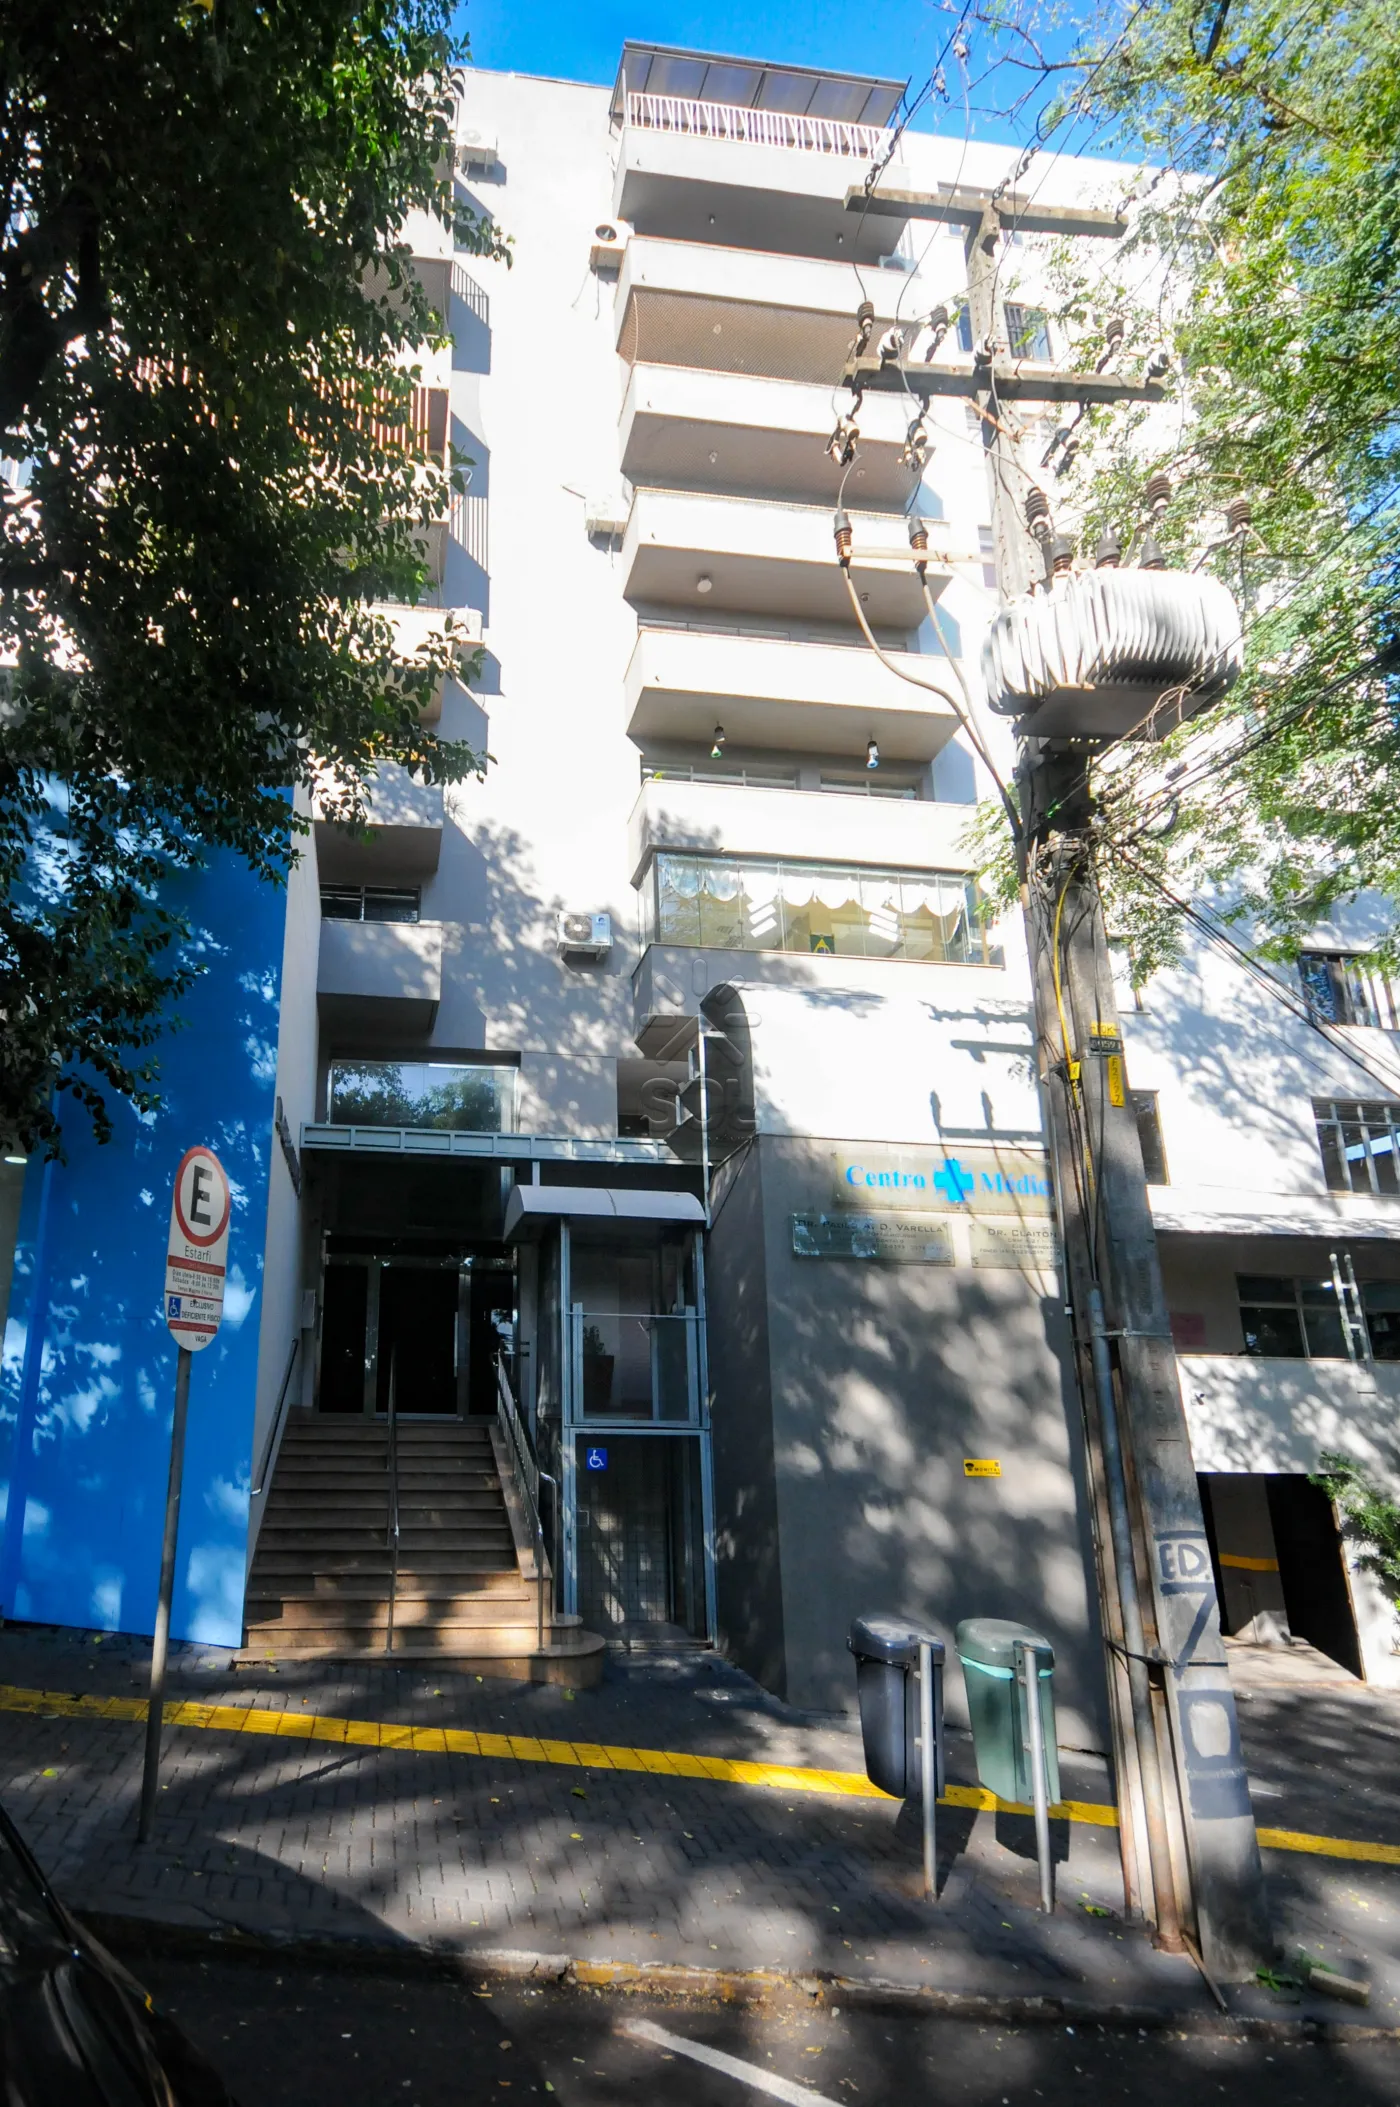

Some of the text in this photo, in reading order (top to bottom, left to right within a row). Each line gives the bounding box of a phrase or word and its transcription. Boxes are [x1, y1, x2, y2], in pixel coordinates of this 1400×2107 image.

[845, 1165, 926, 1189] Centro
[190, 1165, 213, 1226] E
[880, 1222, 892, 1232] D.
[895, 1223, 944, 1234] VARELLA
[987, 1228, 1007, 1237] DR.
[184, 1245, 212, 1263] Estarfi
